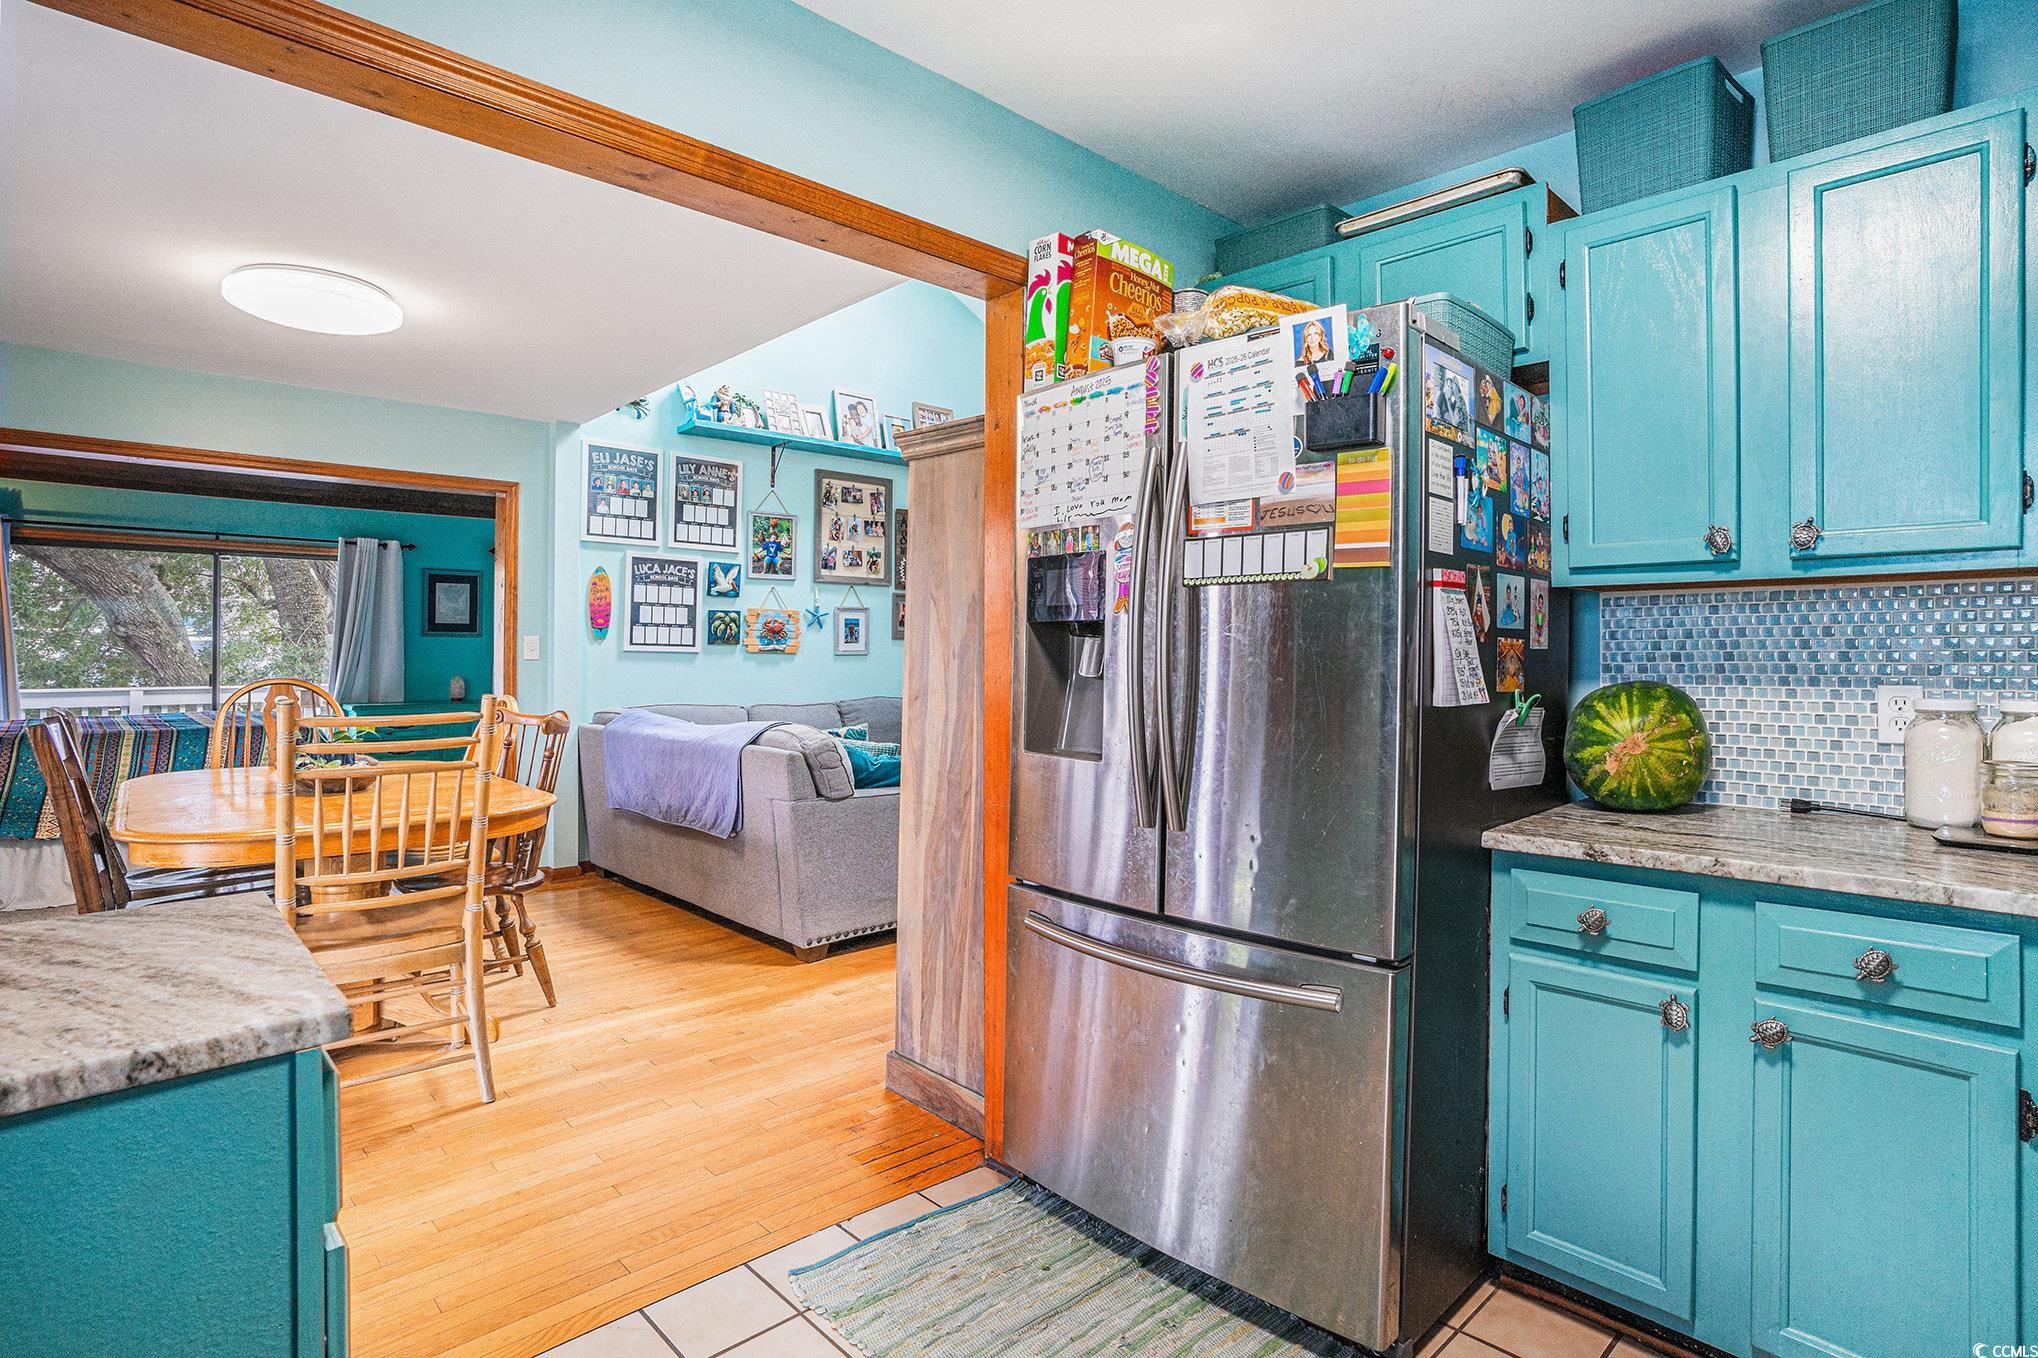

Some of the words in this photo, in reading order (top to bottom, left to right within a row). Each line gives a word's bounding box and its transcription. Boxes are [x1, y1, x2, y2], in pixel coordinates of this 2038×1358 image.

[1034, 242, 1052, 255] CORN
[1034, 251, 1052, 262] FLAKES
[1074, 245, 1096, 259] Cheerios
[1110, 241, 1163, 281] MEGA
[1130, 272, 1152, 291] Honey
[1109, 271, 1162, 312] Cheerios
[1207, 356, 1224, 370] HCS
[1247, 347, 1271, 360] Calendar
[591, 452, 611, 464] ELI
[613, 453, 656, 471] JASE'S
[699, 465, 736, 482] ANNE'S
[633, 563, 661, 575] LUCA
[662, 564, 696, 579] JACE'S
